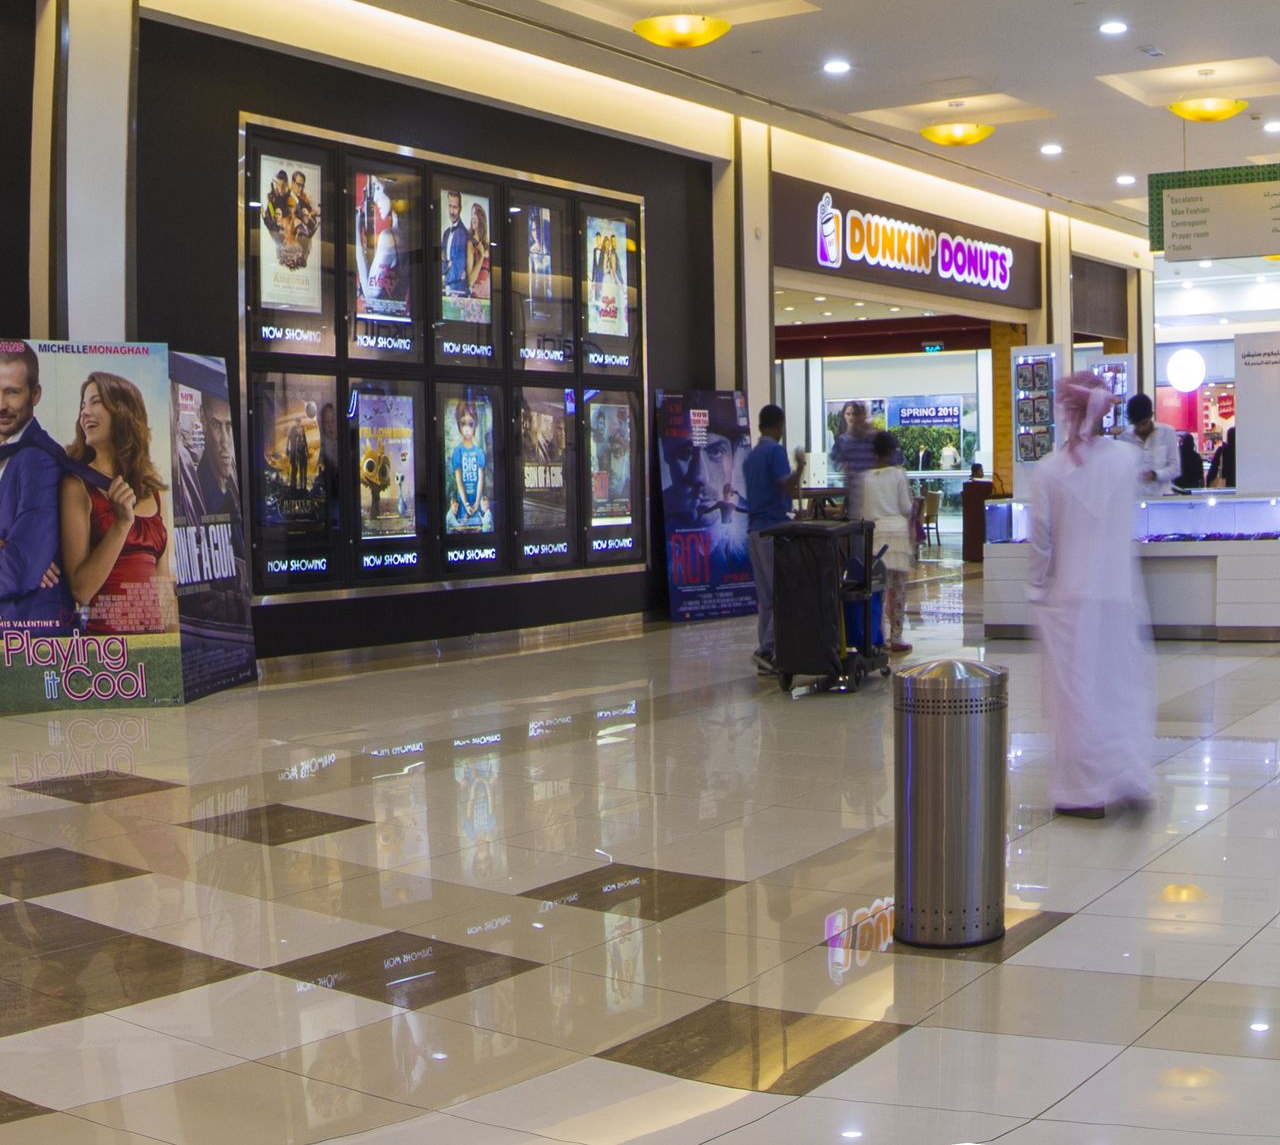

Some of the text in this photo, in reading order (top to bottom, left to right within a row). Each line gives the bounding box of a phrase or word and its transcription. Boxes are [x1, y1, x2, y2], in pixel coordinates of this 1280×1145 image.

[1170, 195, 1203, 205] Escalators
[1171, 206, 1210, 215] Max Fashion
[1171, 231, 1192, 240] Prayer
[849, 214, 1008, 285] DUNKIN' DONUTS
[262, 326, 322, 343] NOW SHOWING
[356, 335, 412, 350] NOW SHOWING
[443, 342, 492, 357] NOW SHOWING
[520, 348, 564, 361] NOW SHOWING
[589, 353, 630, 366] NOW SHOWING
[900, 406, 959, 418] SPRING 2015
[461, 455, 477, 472] BIG
[462, 471, 478, 482] EYES
[524, 542, 568, 556] NOW SHOWING
[592, 537, 633, 550] NOW SHOWING
[209, 523, 236, 580] GUN
[448, 548, 496, 562] NOW SHOWING
[671, 533, 712, 584] ROY
[267, 558, 327, 573] NOW SHOWING
[363, 552, 417, 568] NOW SHOWING
[12, 619, 61, 628] VALENTINE'S
[3, 628, 127, 673] Playing
[43, 670, 61, 699] it
[62, 662, 147, 701] Cool
